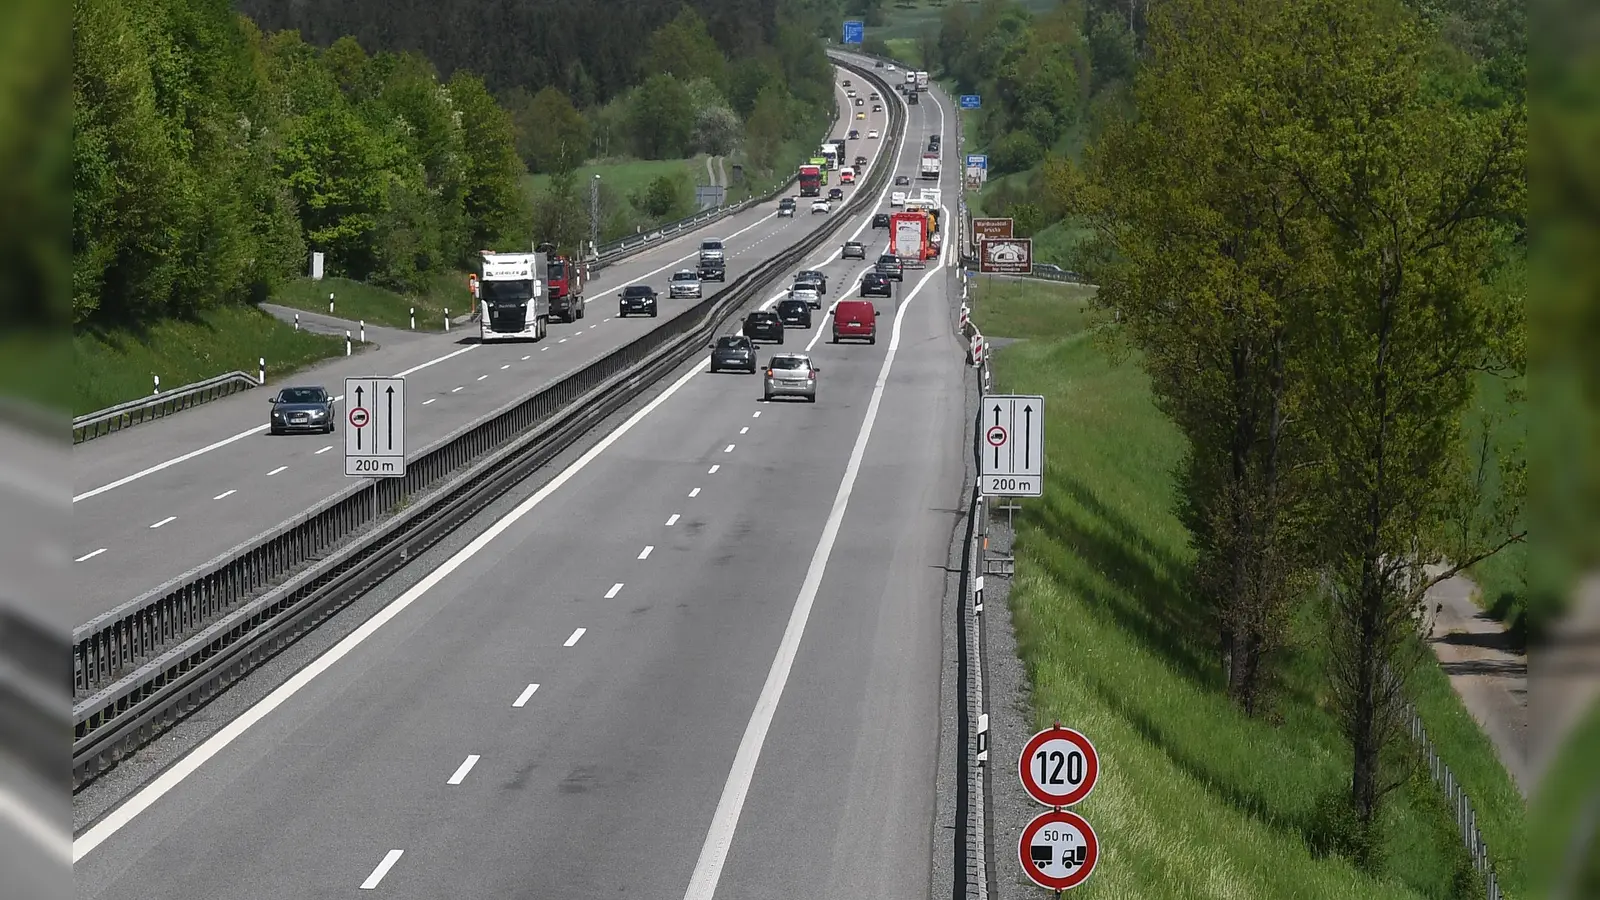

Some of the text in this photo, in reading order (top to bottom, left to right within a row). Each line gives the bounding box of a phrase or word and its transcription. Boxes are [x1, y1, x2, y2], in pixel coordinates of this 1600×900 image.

[356, 460, 393, 471] 200 m
[992, 478, 1030, 490] 200 m
[1036, 751, 1082, 785] 120
[1044, 830, 1073, 842] 50 m
